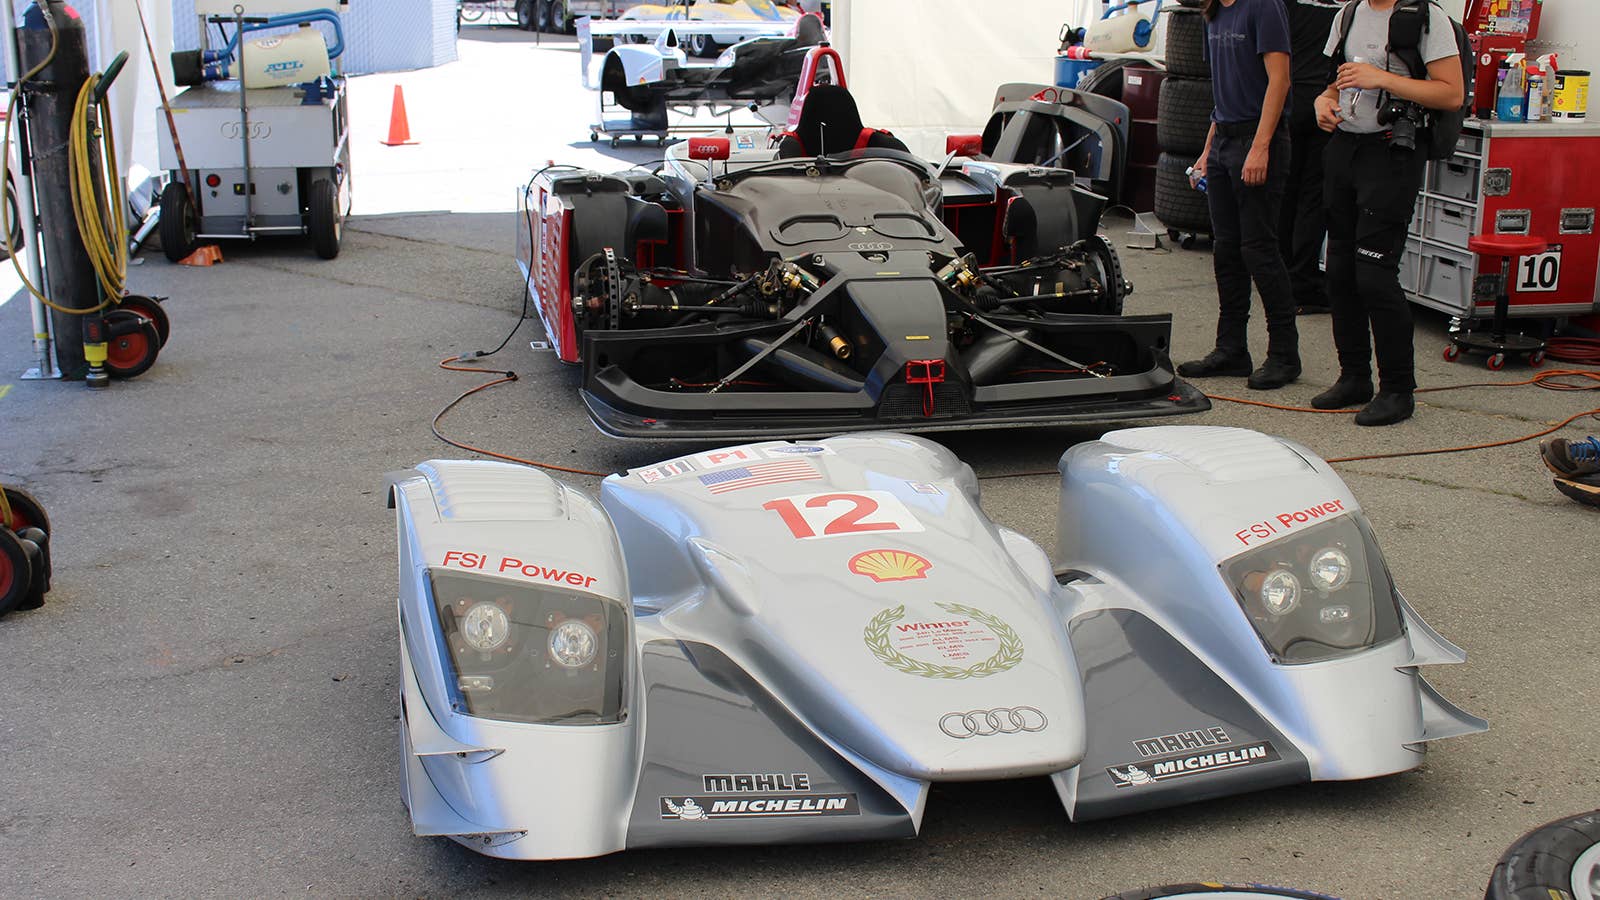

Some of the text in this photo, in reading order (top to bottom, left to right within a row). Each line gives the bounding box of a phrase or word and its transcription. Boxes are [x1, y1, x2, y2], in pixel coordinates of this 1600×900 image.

[264, 60, 304, 73] ATL
[1521, 255, 1558, 289] 10
[707, 451, 747, 464] P1
[762, 493, 901, 539] 12
[1235, 499, 1345, 546] FSI Power
[442, 551, 598, 588] FSI Power
[896, 621, 969, 632] Winner
[1132, 726, 1232, 757] MAHLE
[1153, 745, 1267, 775] MICHELIN
[702, 773, 811, 793] MAHLE
[711, 798, 848, 813] MICHELIN
